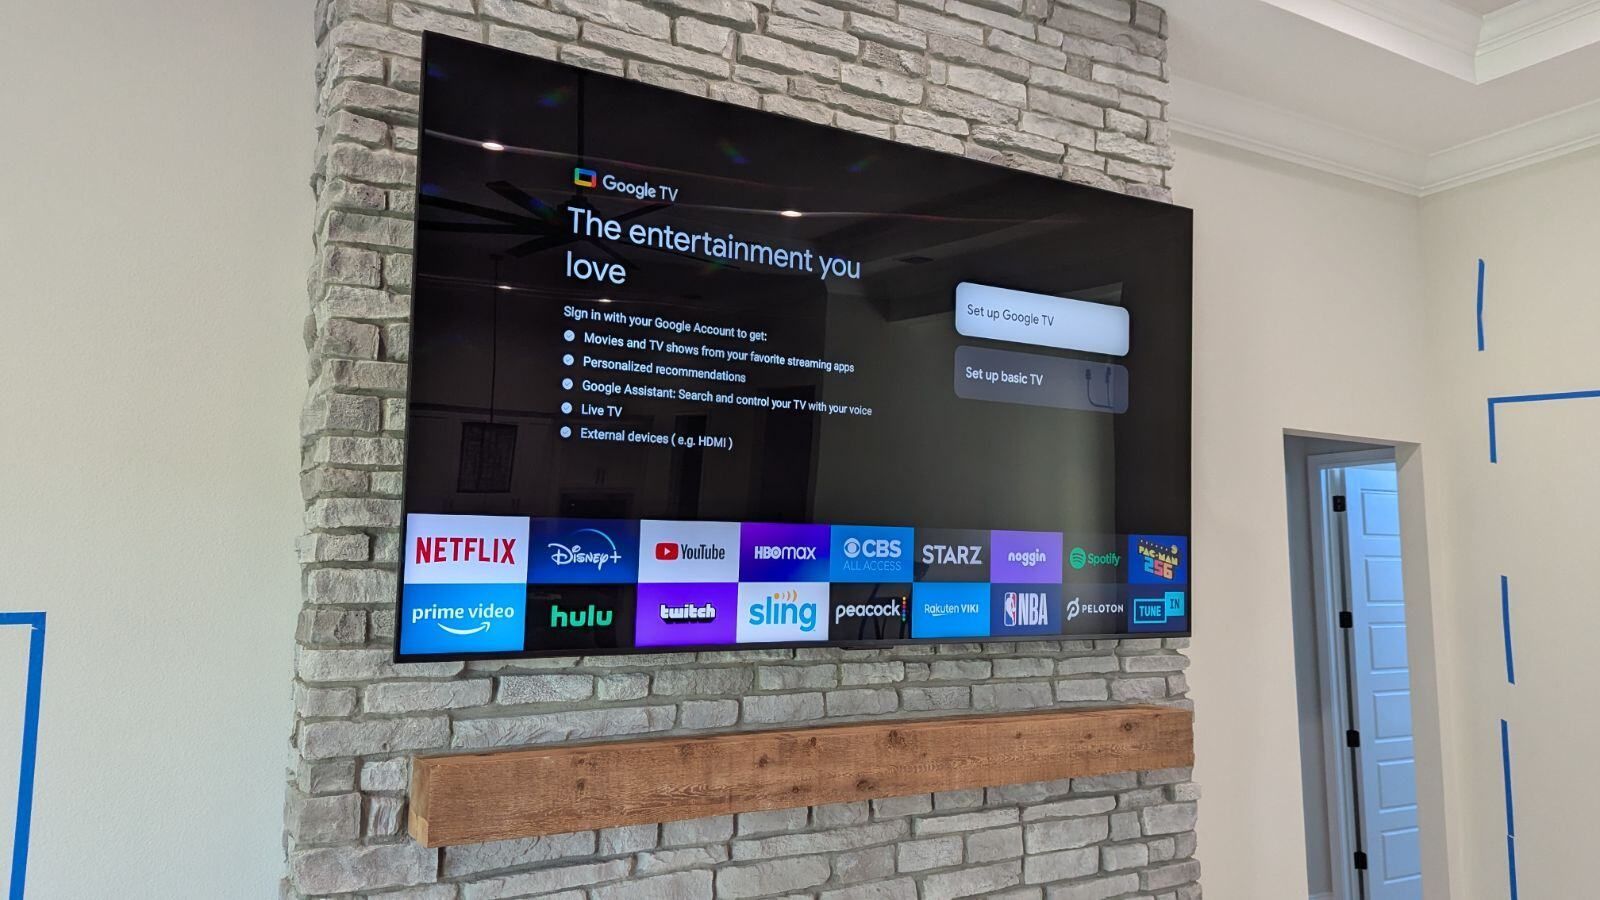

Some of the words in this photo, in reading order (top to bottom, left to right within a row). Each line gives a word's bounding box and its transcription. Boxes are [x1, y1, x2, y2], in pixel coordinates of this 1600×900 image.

[603, 175, 656, 199] Google
[659, 186, 678, 201] TV
[568, 207, 621, 240] The
[630, 224, 813, 272] entertainment
[819, 255, 861, 280] you
[566, 251, 626, 284] love
[564, 306, 588, 320] Sign
[591, 310, 600, 320] in
[604, 313, 626, 324] with
[629, 317, 652, 328] your
[655, 318, 691, 332] Google
[693, 322, 735, 337] Account
[737, 328, 747, 338] to
[749, 331, 767, 342] get:
[967, 304, 984, 317] Set
[987, 310, 999, 320] up
[1003, 309, 1039, 326] Google
[1042, 315, 1054, 326] TV
[584, 333, 624, 347] Movies
[626, 337, 646, 350] and
[649, 340, 664, 351] TV
[666, 342, 699, 356] shows
[701, 346, 725, 358] from
[727, 350, 748, 361] your
[750, 352, 785, 365] favorite
[787, 356, 832, 371] streaming
[834, 362, 854, 373] apps
[583, 356, 653, 373] Personalized
[656, 364, 746, 383] recommendations
[966, 367, 983, 379] Set
[986, 372, 998, 384] up
[1001, 370, 1027, 384] basic
[1030, 374, 1043, 386] TV
[582, 380, 621, 395] Google
[624, 384, 676, 399] Assistant:
[679, 389, 713, 402] Search
[715, 392, 733, 403] and
[736, 394, 769, 407] control
[772, 398, 792, 409] your
[793, 399, 807, 409] TV
[808, 401, 827, 412] with
[829, 404, 847, 414] your
[850, 405, 872, 416] voice
[581, 404, 604, 416] Live
[607, 406, 622, 417] TV
[580, 428, 625, 441] External
[628, 431, 668, 444] devices
[678, 435, 695, 447] e.g.
[698, 435, 726, 447] HDMI
[416, 537, 516, 565] NETFLIX
[681, 544, 725, 560] YouTube
[862, 539, 901, 558] CBS
[922, 544, 982, 565] STARZ
[1008, 549, 1046, 566] noggin
[844, 560, 863, 571] ALL
[863, 560, 901, 571] ACCESS
[1087, 552, 1121, 567] Spotify
[1144, 558, 1174, 580] 256
[412, 604, 464, 624] prime
[468, 603, 514, 619] video
[660, 603, 716, 624] twitch
[749, 592, 817, 632] sling
[835, 599, 901, 624] peacock
[924, 604, 959, 617] Rakuten
[961, 604, 978, 614] VIKI
[1019, 593, 1048, 625] NBA
[1082, 603, 1124, 614] PELOTON
[1139, 605, 1162, 617] TUNE
[1170, 598, 1180, 609] IN
[551, 604, 613, 627] hulu
